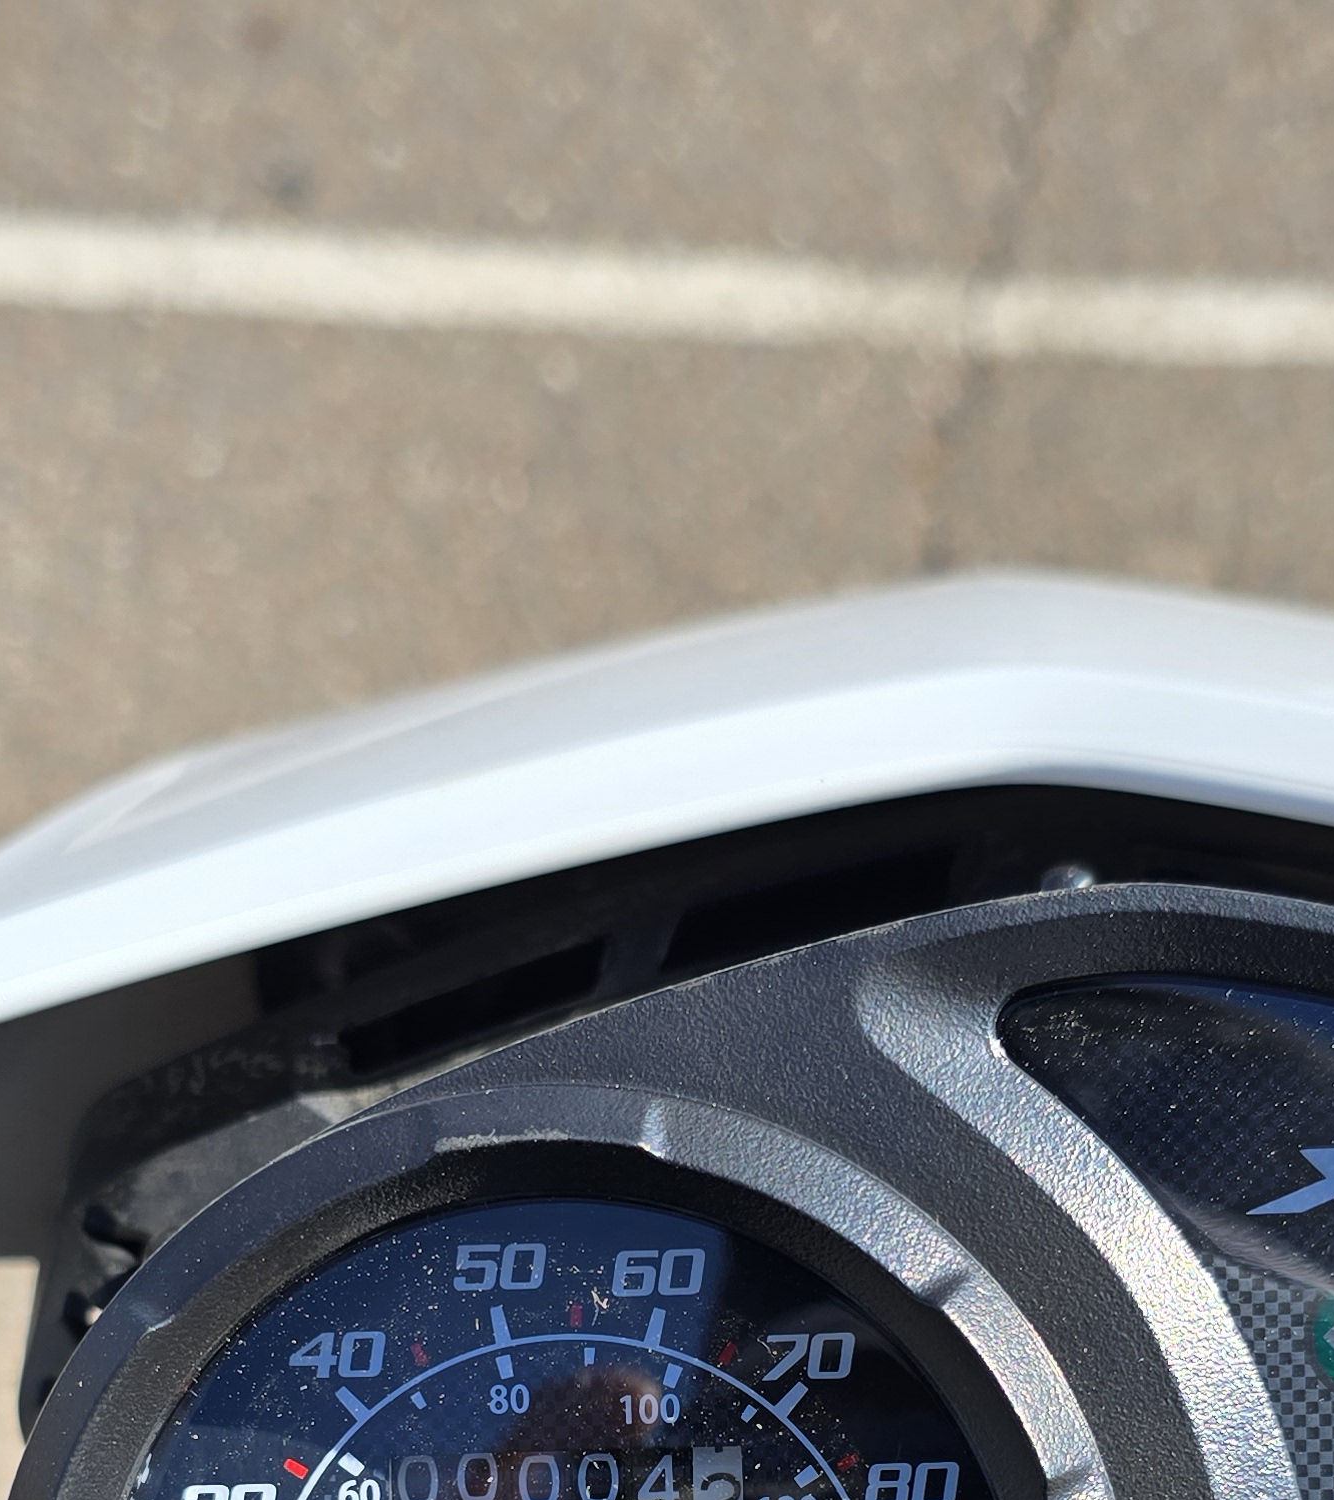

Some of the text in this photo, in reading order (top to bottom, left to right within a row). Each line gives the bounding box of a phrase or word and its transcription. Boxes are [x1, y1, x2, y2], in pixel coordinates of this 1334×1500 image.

[453, 1242, 548, 1293] 50
[611, 1247, 706, 1298] 60
[288, 1330, 387, 1379] 40
[762, 1331, 856, 1382] 70
[488, 1383, 531, 1415] 80
[619, 1393, 681, 1427] 100
